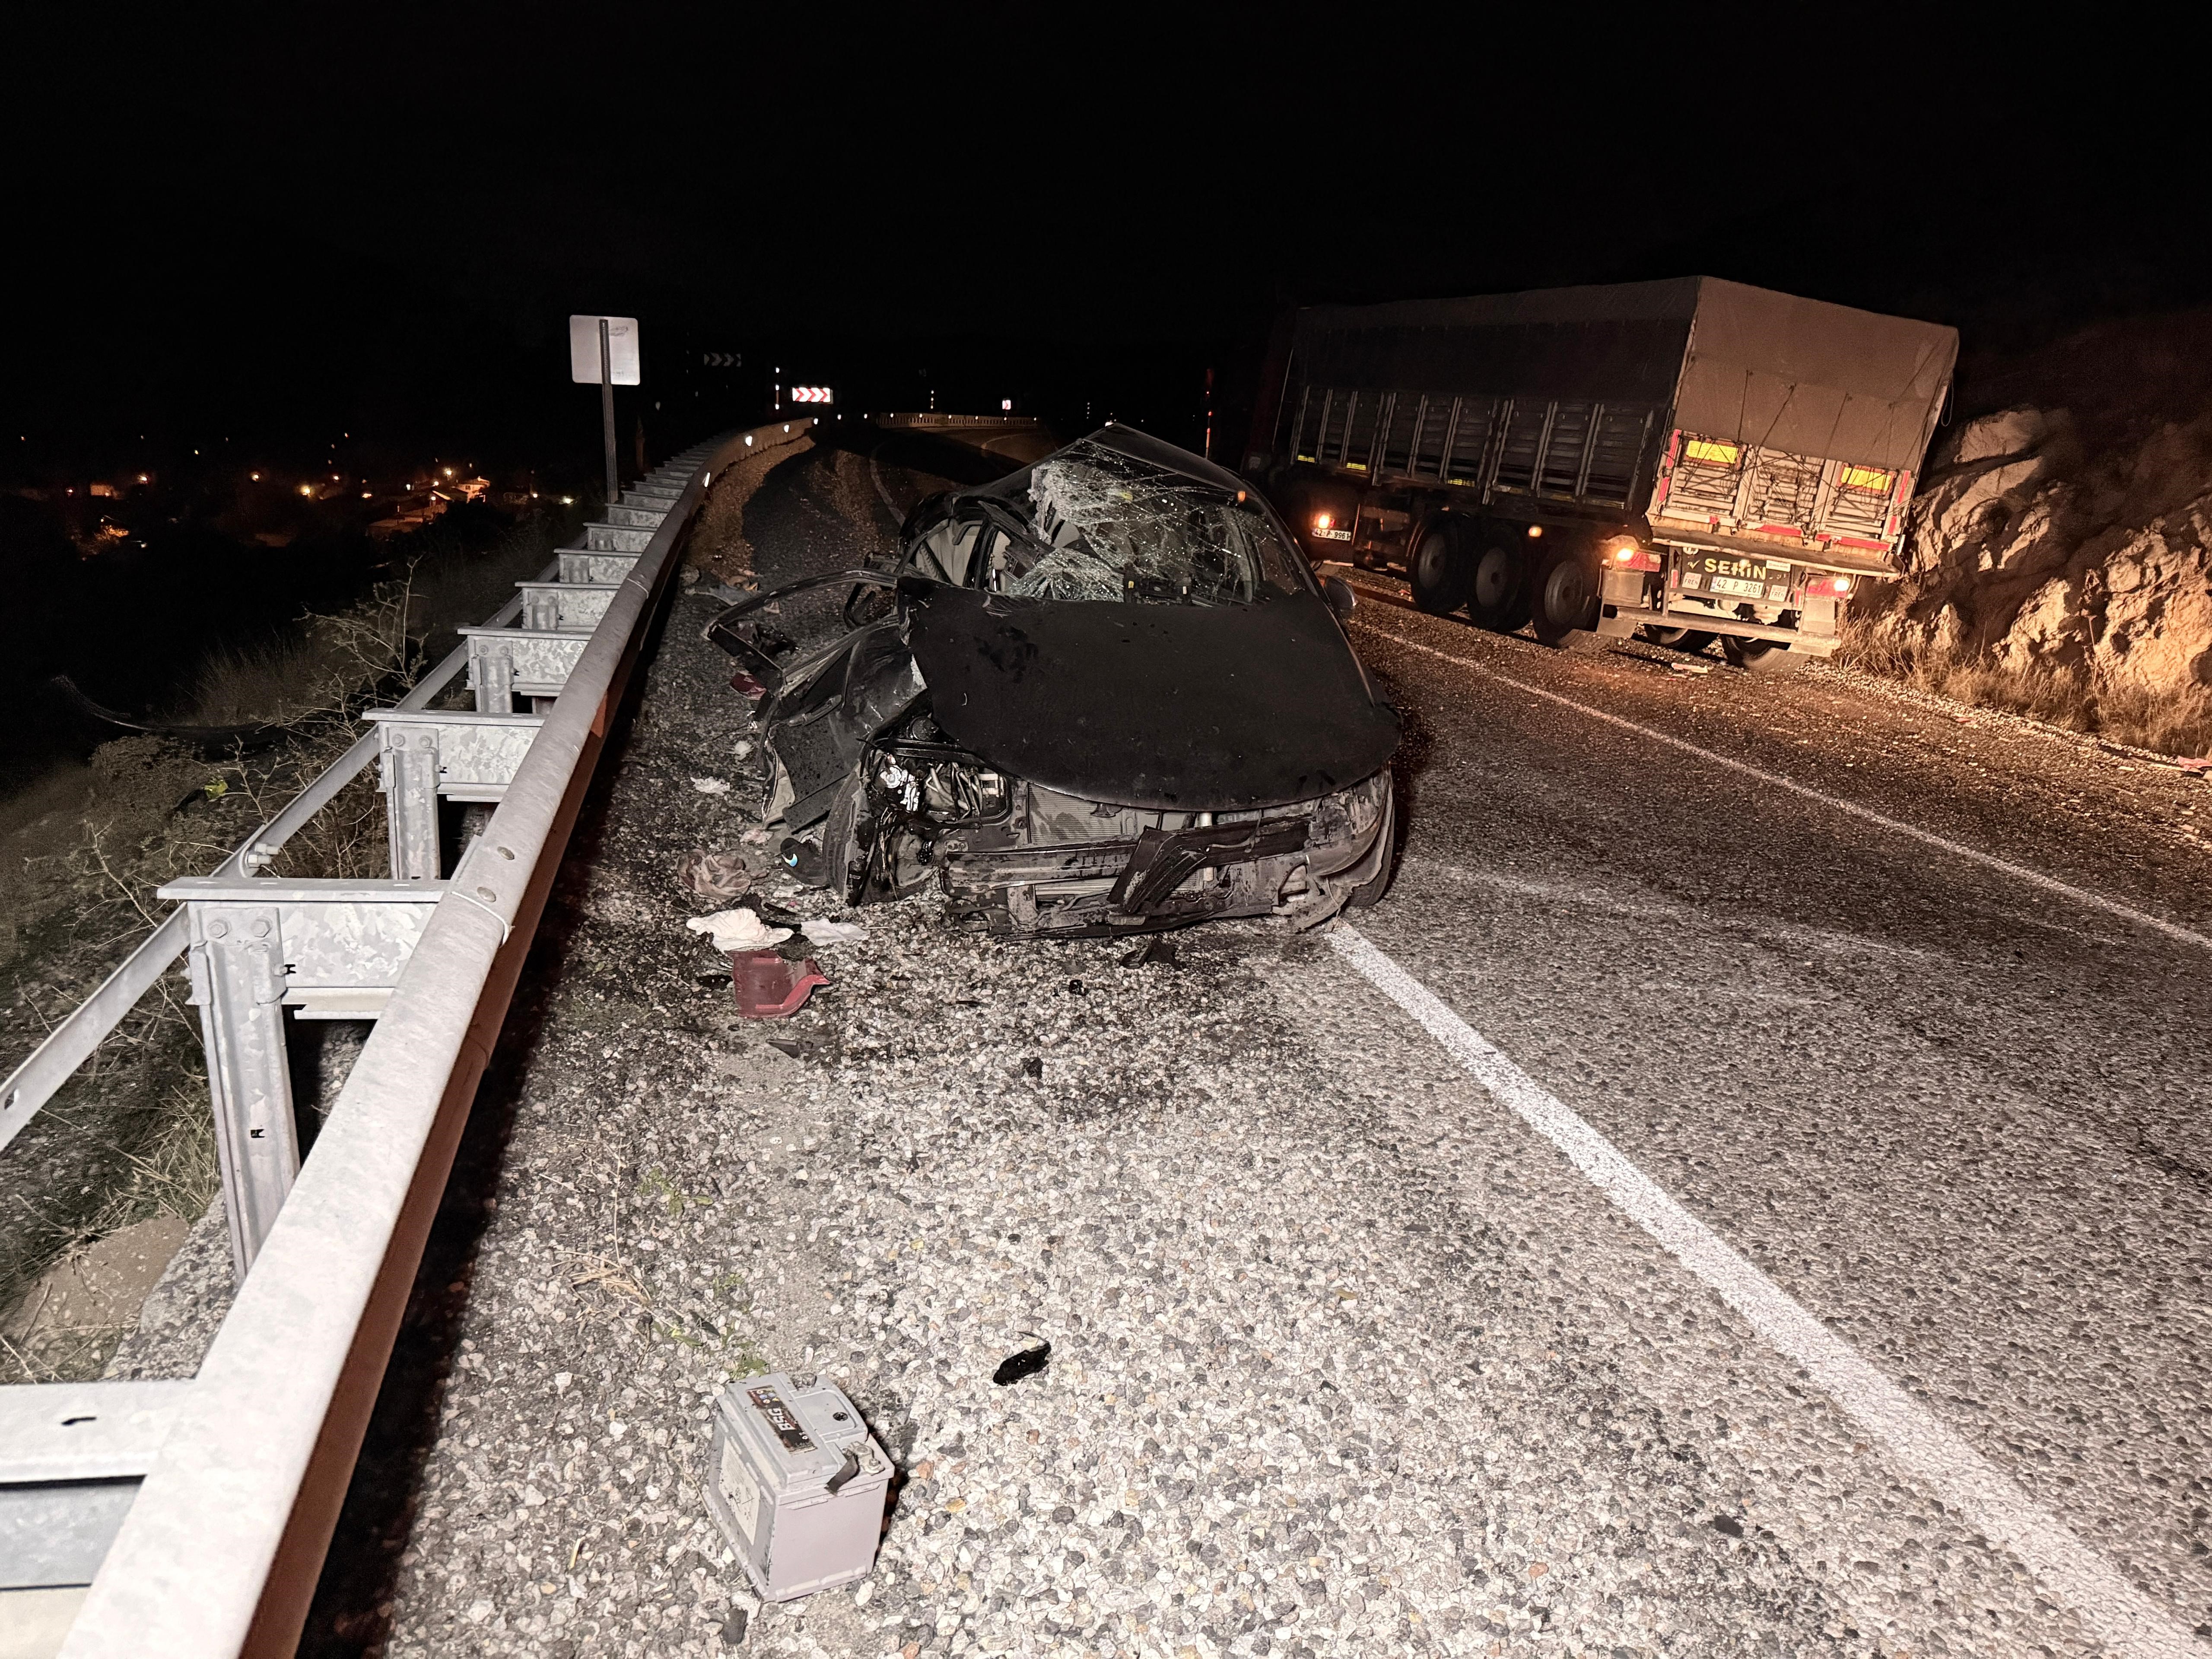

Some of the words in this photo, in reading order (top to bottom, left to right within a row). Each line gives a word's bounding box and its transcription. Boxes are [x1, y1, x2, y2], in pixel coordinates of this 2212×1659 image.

[1717, 579, 1727, 589] 42
[1733, 581, 1738, 590] P
[1744, 582, 1761, 593] 3261
